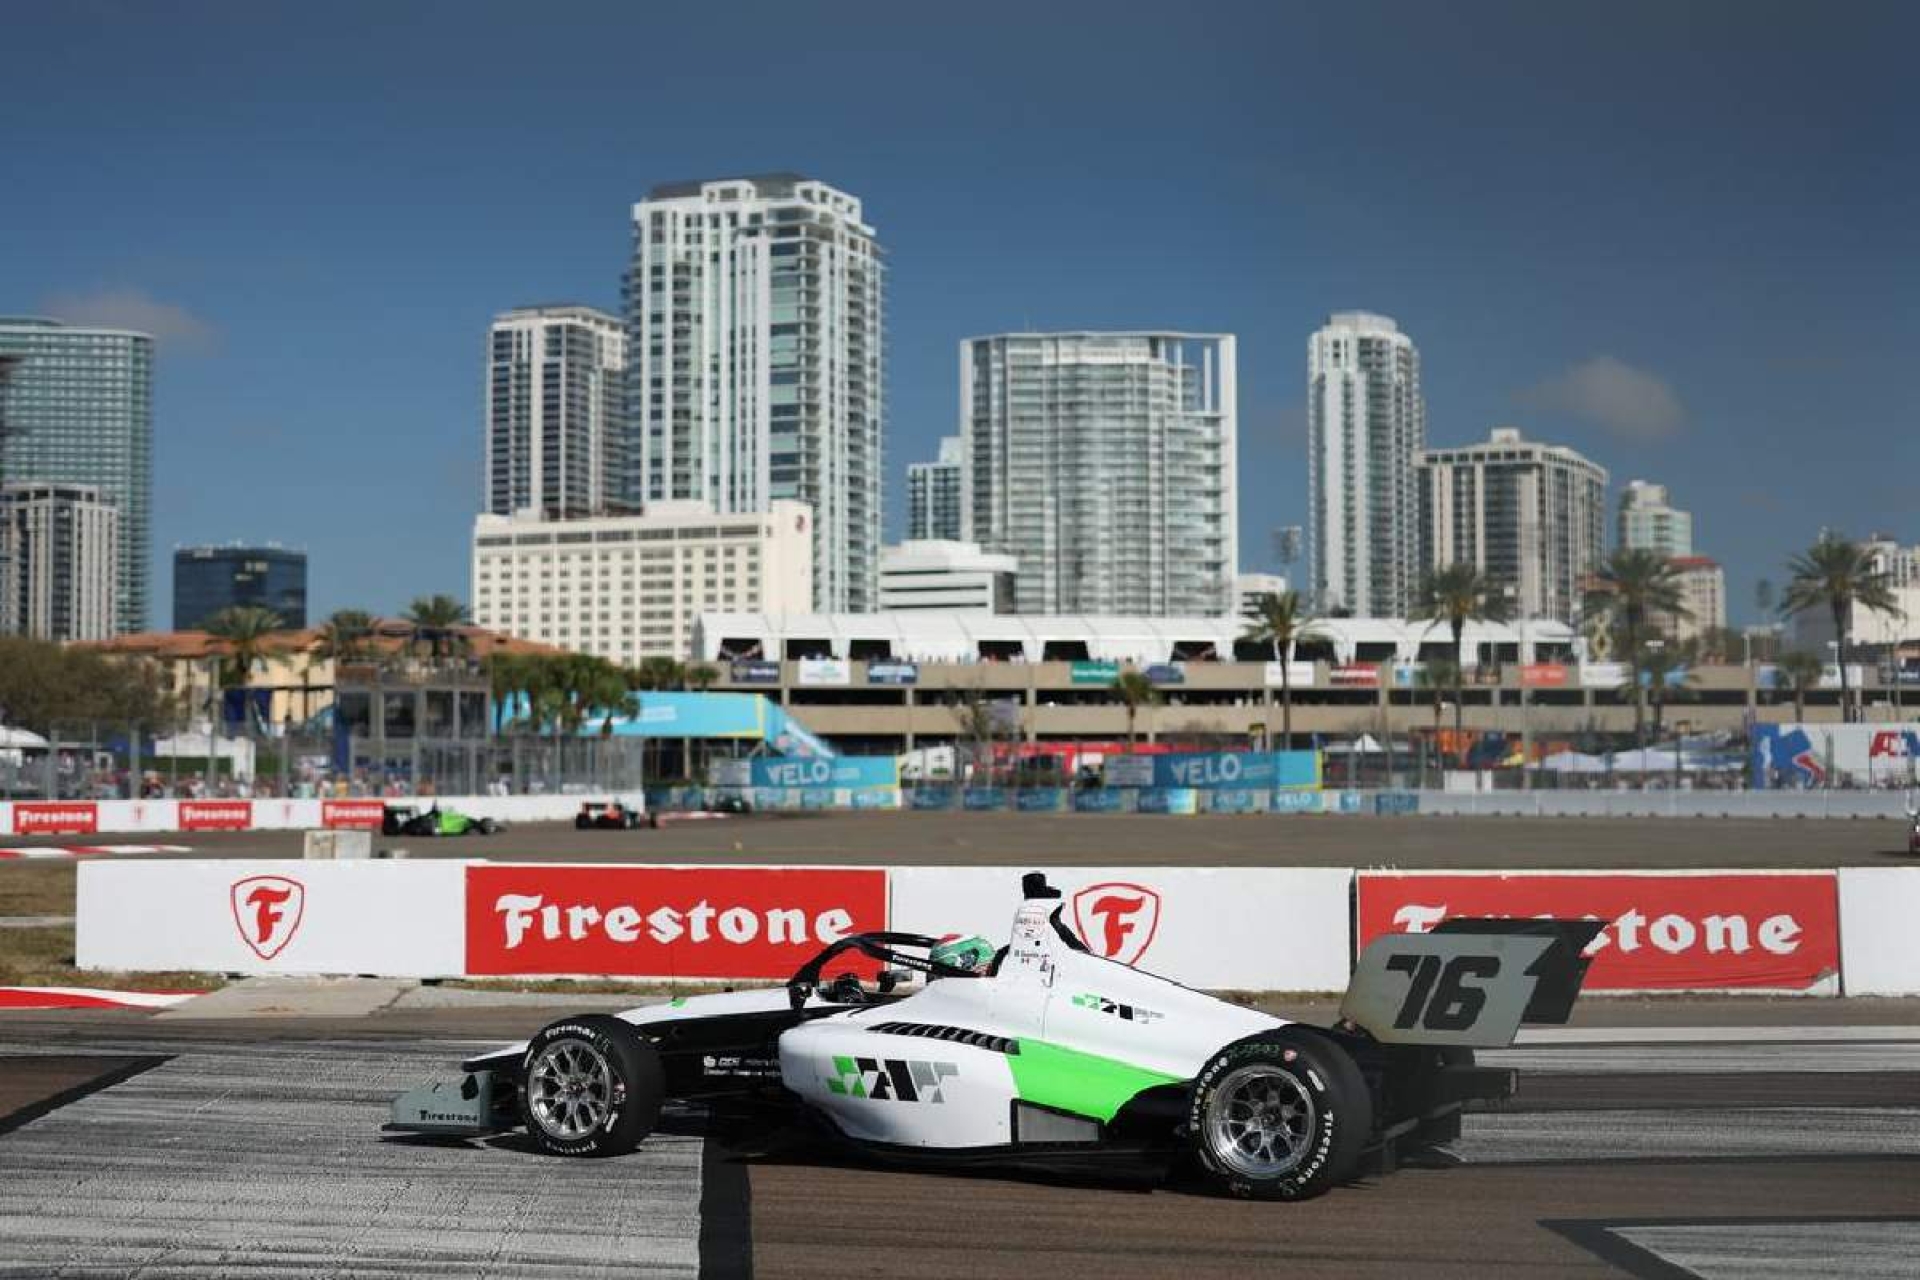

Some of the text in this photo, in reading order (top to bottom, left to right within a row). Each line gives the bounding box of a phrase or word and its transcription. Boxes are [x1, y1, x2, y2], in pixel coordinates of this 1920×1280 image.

[767, 762, 830, 785] VELO
[1170, 756, 1241, 786] VELO
[18, 810, 93, 826] Firestone
[182, 805, 248, 821] Firestone
[247, 886, 291, 944] F
[495, 894, 854, 949] Firestone
[1386, 954, 1501, 1031] 76
